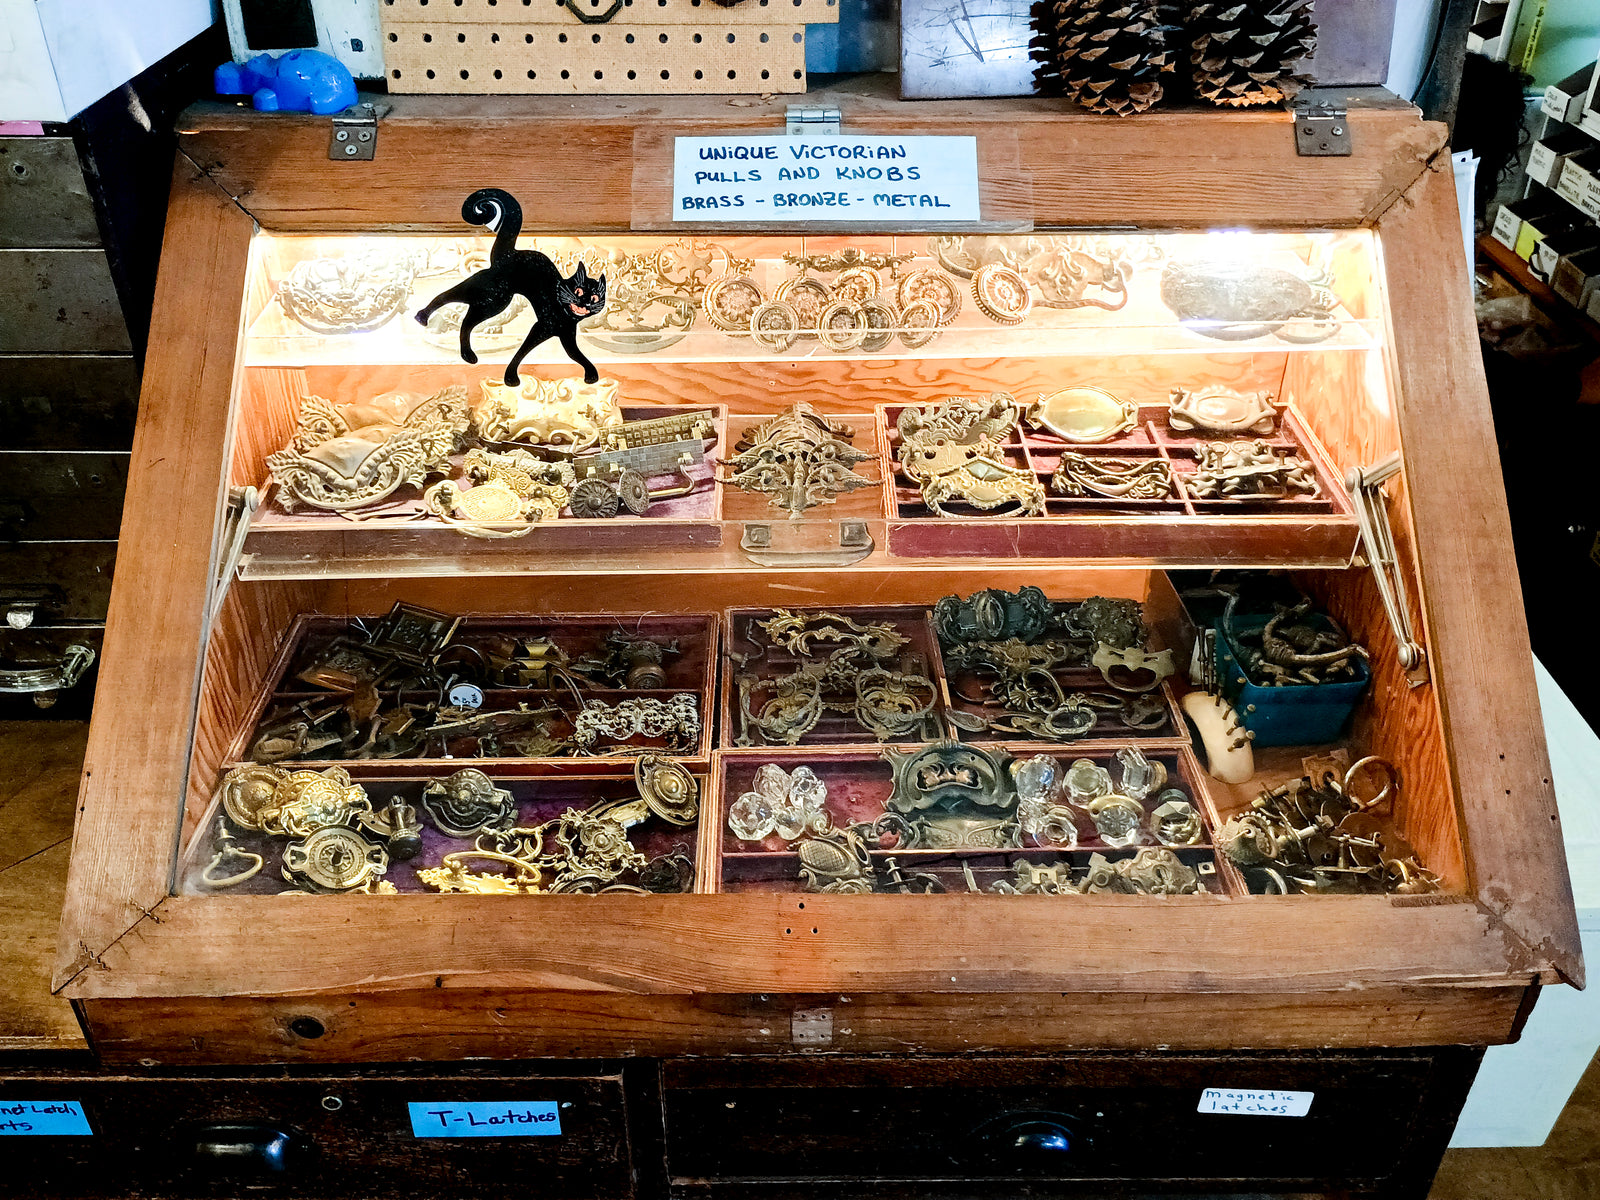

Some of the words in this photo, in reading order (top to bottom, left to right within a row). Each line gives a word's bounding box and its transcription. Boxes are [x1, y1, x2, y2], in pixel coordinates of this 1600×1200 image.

[694, 168, 762, 184] PULLS
[778, 167, 820, 182] AND
[835, 166, 921, 182] KNOBS
[682, 194, 745, 210] BRASS
[773, 192, 851, 208] BRONZE
[873, 193, 951, 208] METAL
[427, 1110, 556, 1127] T-Latches
